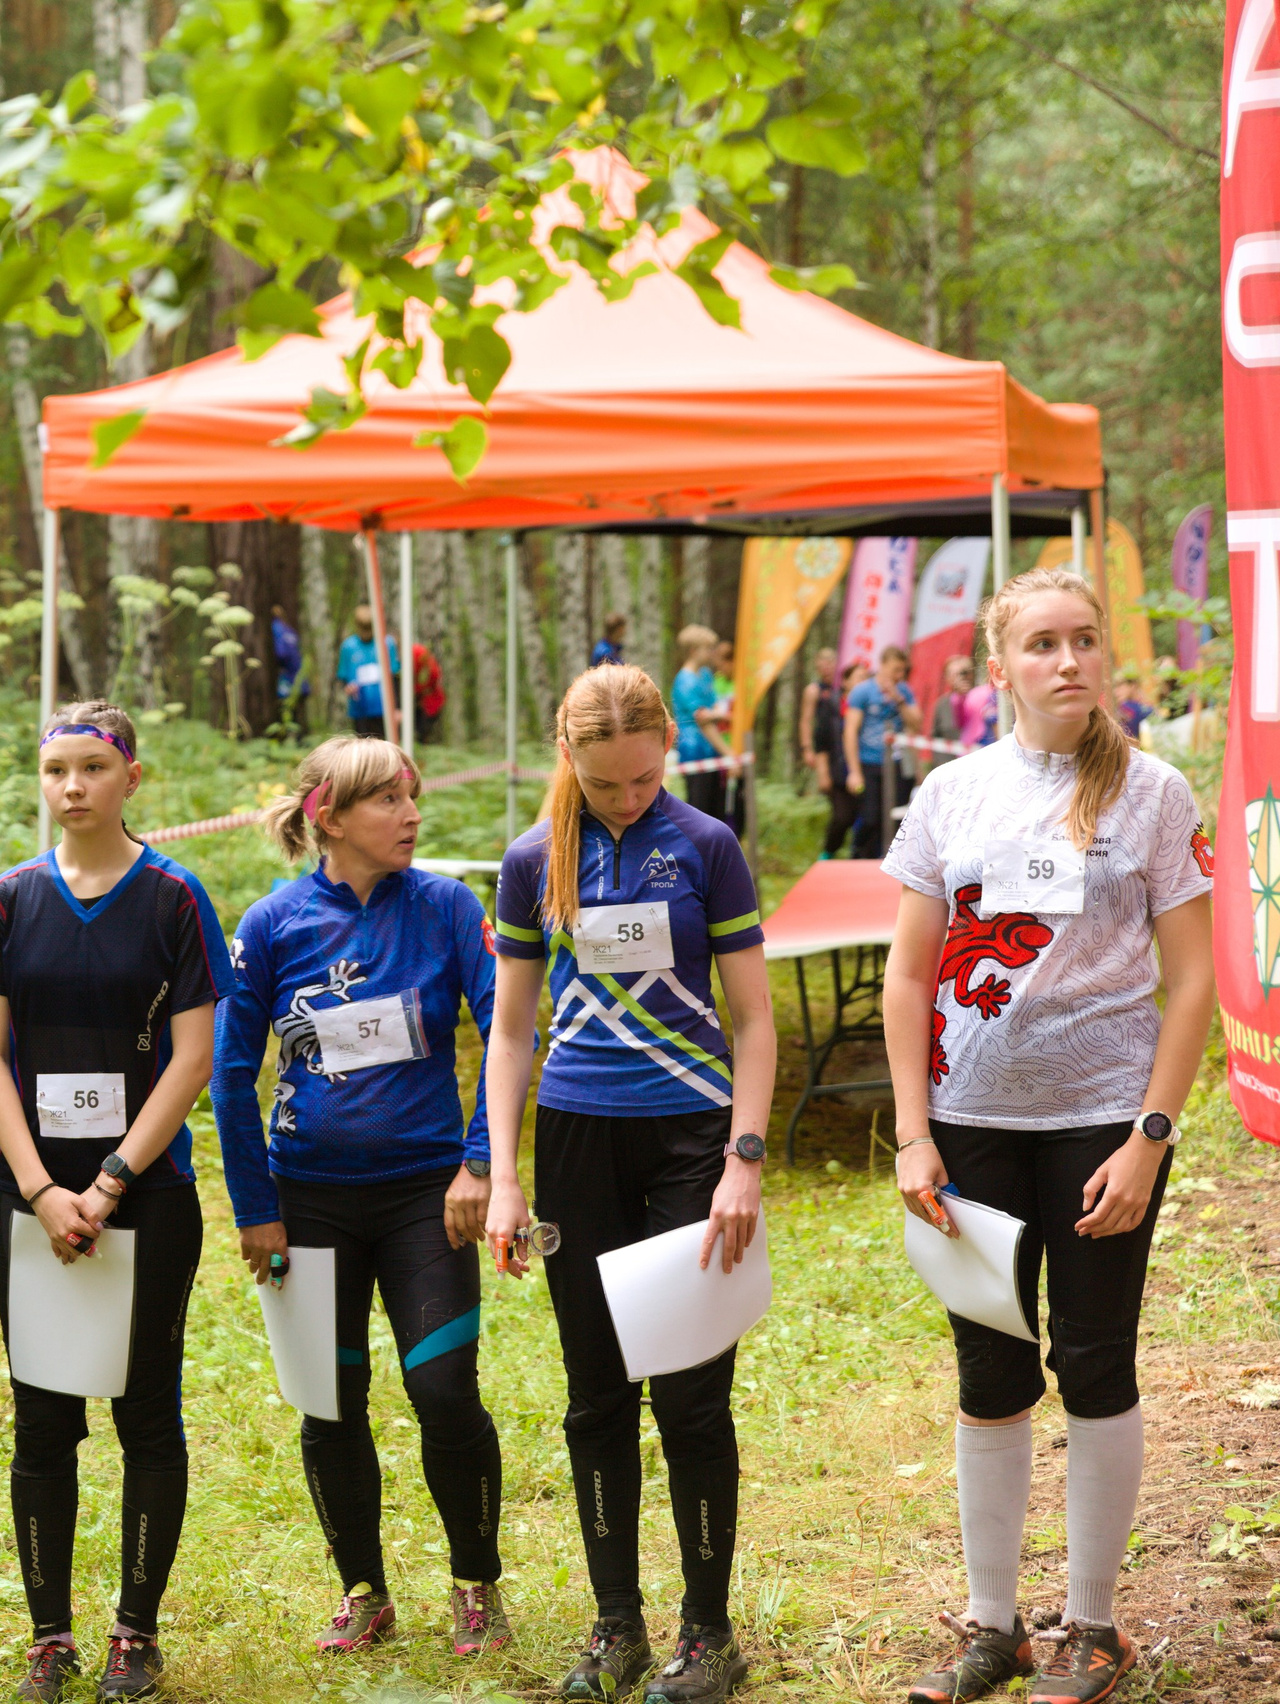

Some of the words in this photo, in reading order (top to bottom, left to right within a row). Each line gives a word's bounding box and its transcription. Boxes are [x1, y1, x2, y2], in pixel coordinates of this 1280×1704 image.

[595, 836, 605, 872] VICTORY
[1027, 859, 1055, 880] 59
[597, 875, 605, 900] CODE
[650, 881, 675, 889] ТРОПА
[617, 922, 645, 943] 58
[592, 945, 612, 954] Ж21
[358, 1018, 382, 1039] 57
[336, 1043, 355, 1052] Ж21
[73, 1089, 100, 1109] 56
[49, 1110, 67, 1118] Ж21
[481, 1476, 489, 1520] NORD
[594, 1470, 604, 1520] NORD
[700, 1499, 709, 1545] NORD
[30, 1516, 40, 1570] NORD
[137, 1513, 148, 1567] NORD
